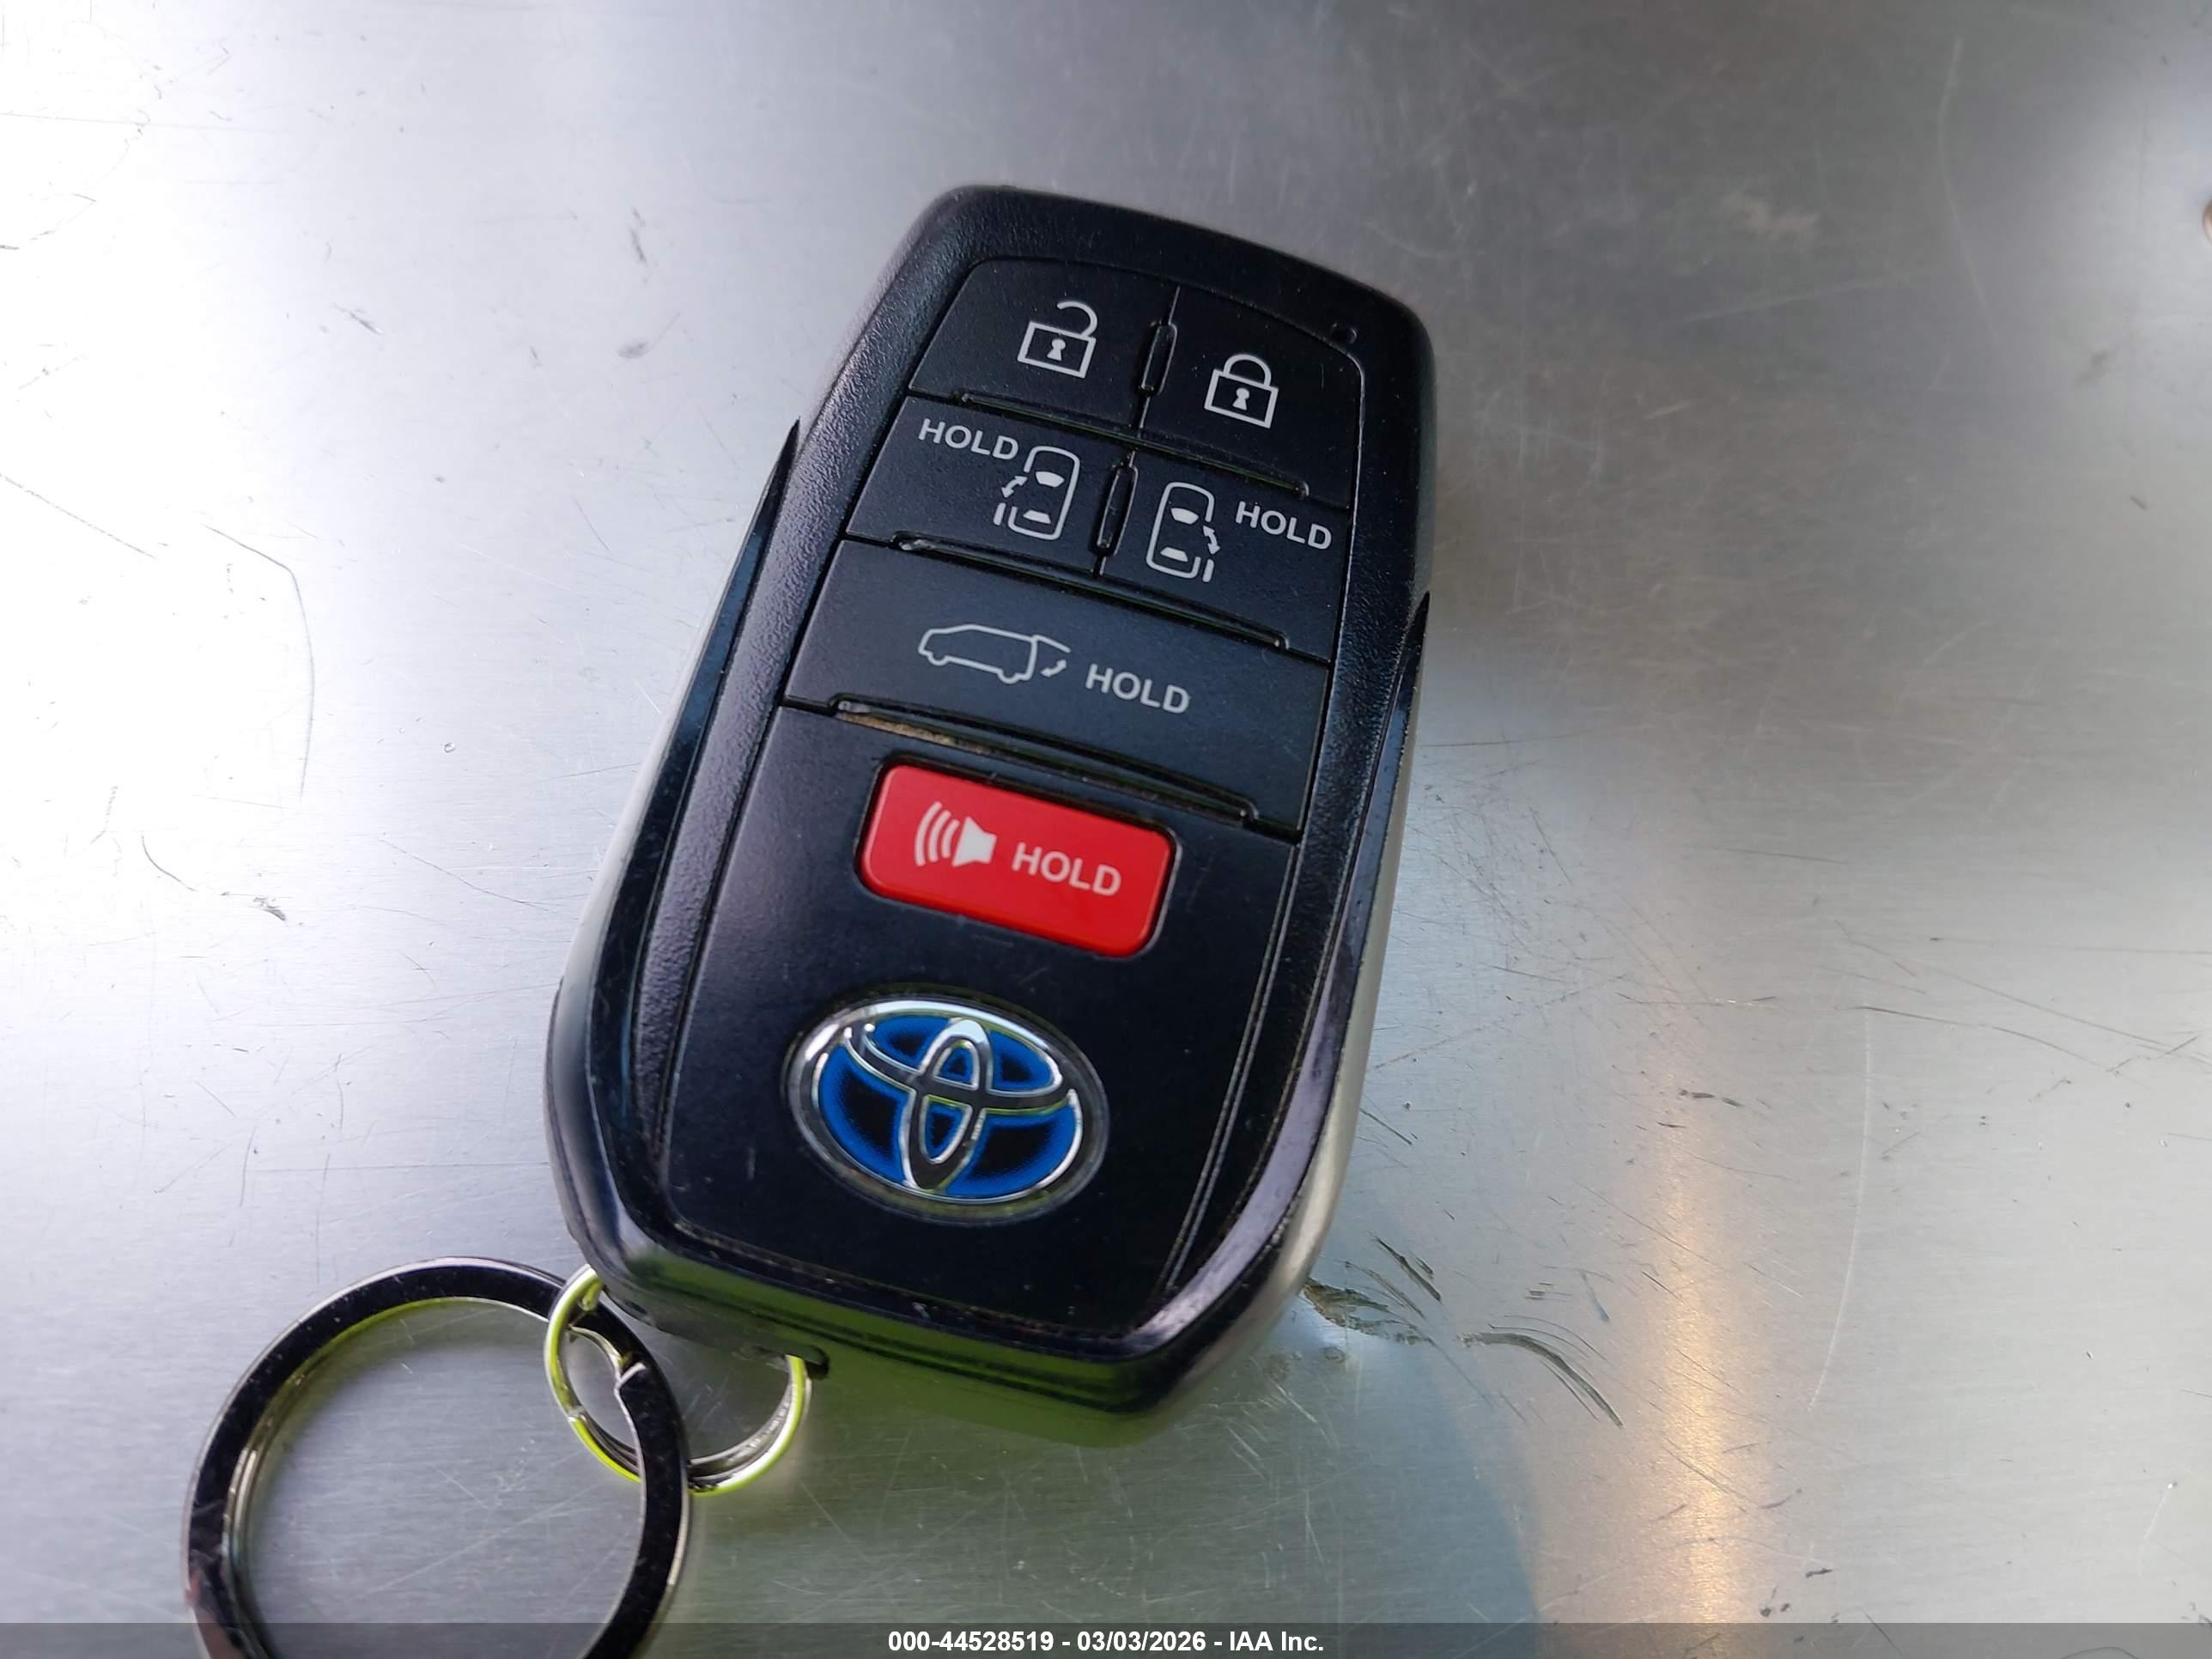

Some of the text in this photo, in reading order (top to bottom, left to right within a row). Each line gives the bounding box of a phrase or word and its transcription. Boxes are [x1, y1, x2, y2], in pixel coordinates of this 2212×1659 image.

[918, 418, 1019, 460] HOLD
[1235, 501, 1332, 550] HOLD
[1085, 663, 1190, 714] HOLD
[1012, 842, 1121, 896] HOLD
